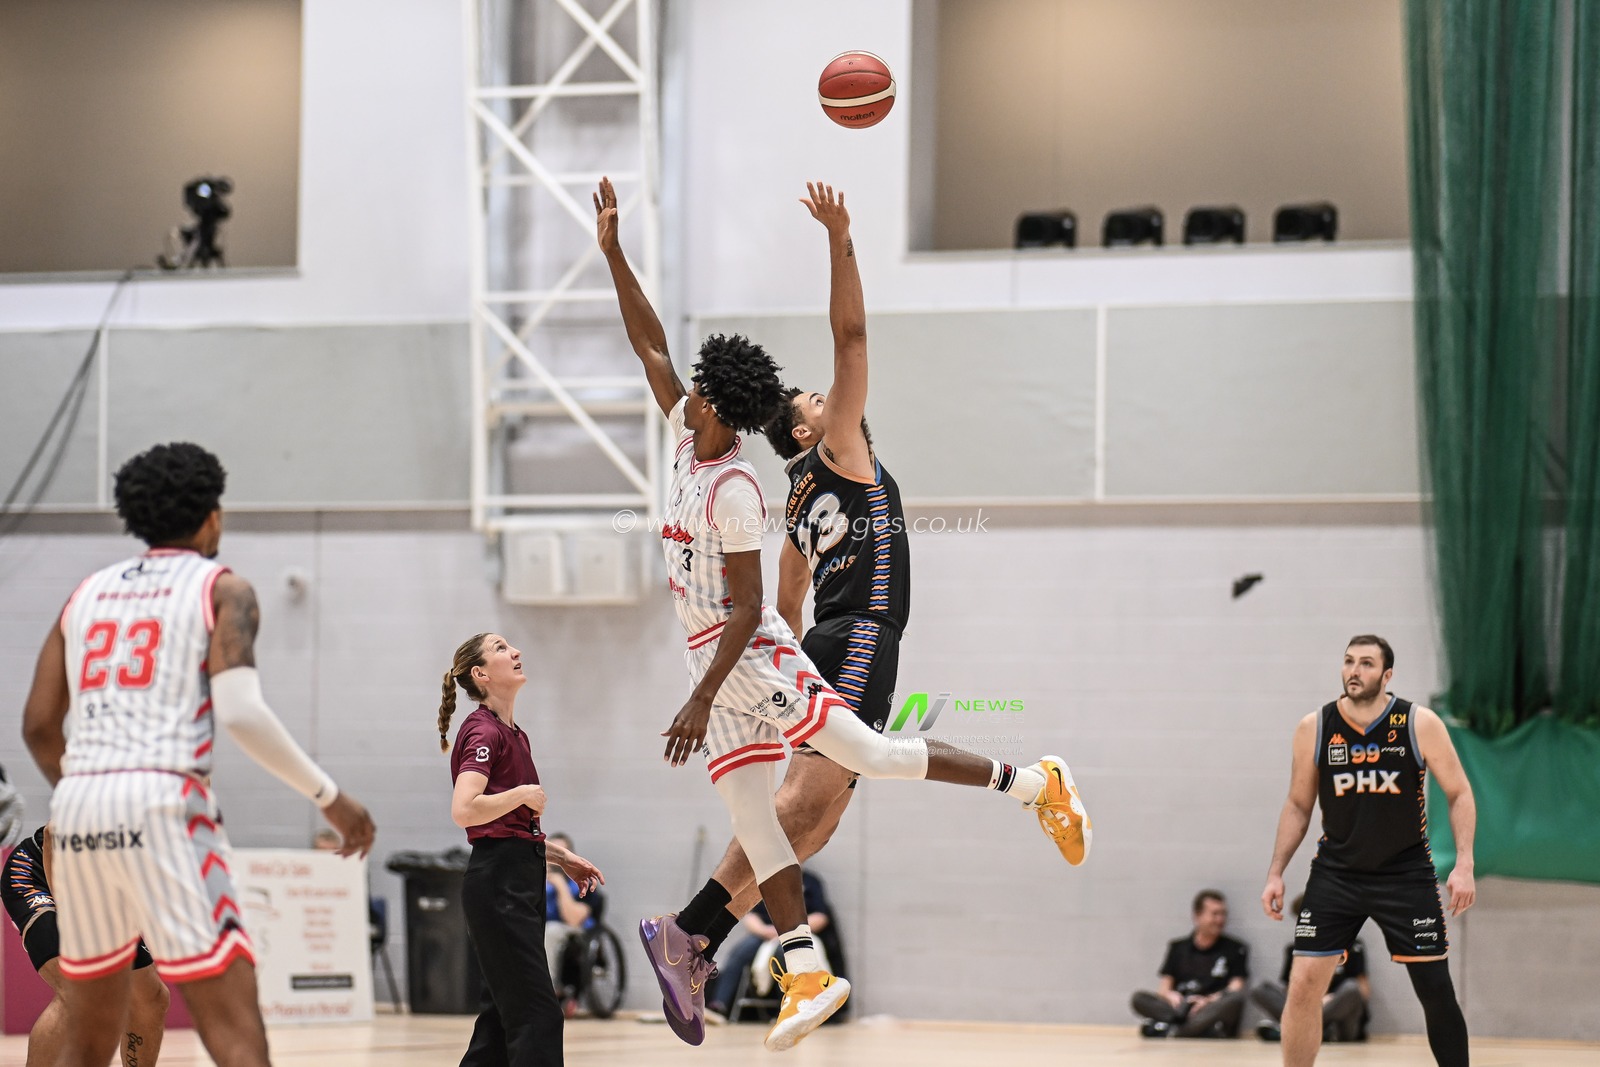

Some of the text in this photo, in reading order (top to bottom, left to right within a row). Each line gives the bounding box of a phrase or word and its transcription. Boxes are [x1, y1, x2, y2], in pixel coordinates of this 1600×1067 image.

[840, 111, 875, 121] molten
[78, 617, 163, 692] 23
[1350, 742, 1381, 764] 99
[1333, 769, 1402, 797] PHX
